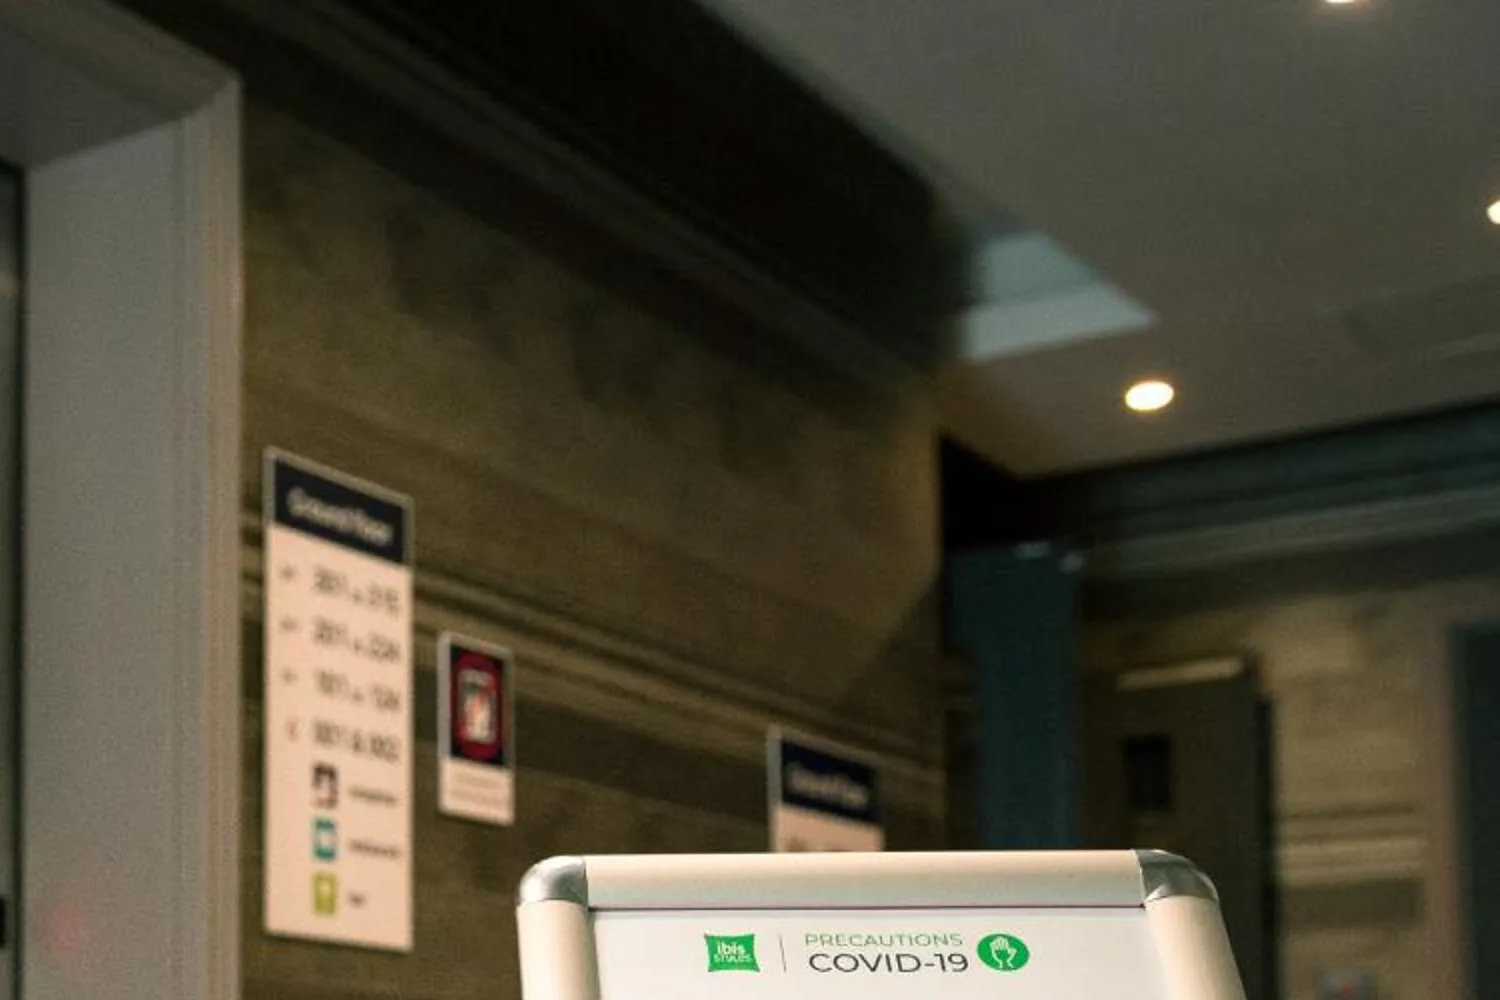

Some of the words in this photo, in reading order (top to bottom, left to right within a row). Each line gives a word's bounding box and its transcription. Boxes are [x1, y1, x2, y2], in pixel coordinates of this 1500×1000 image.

[717, 940, 747, 955] ibis
[804, 933, 964, 948] PRECAUTIONS
[807, 952, 970, 973] COVID-19
